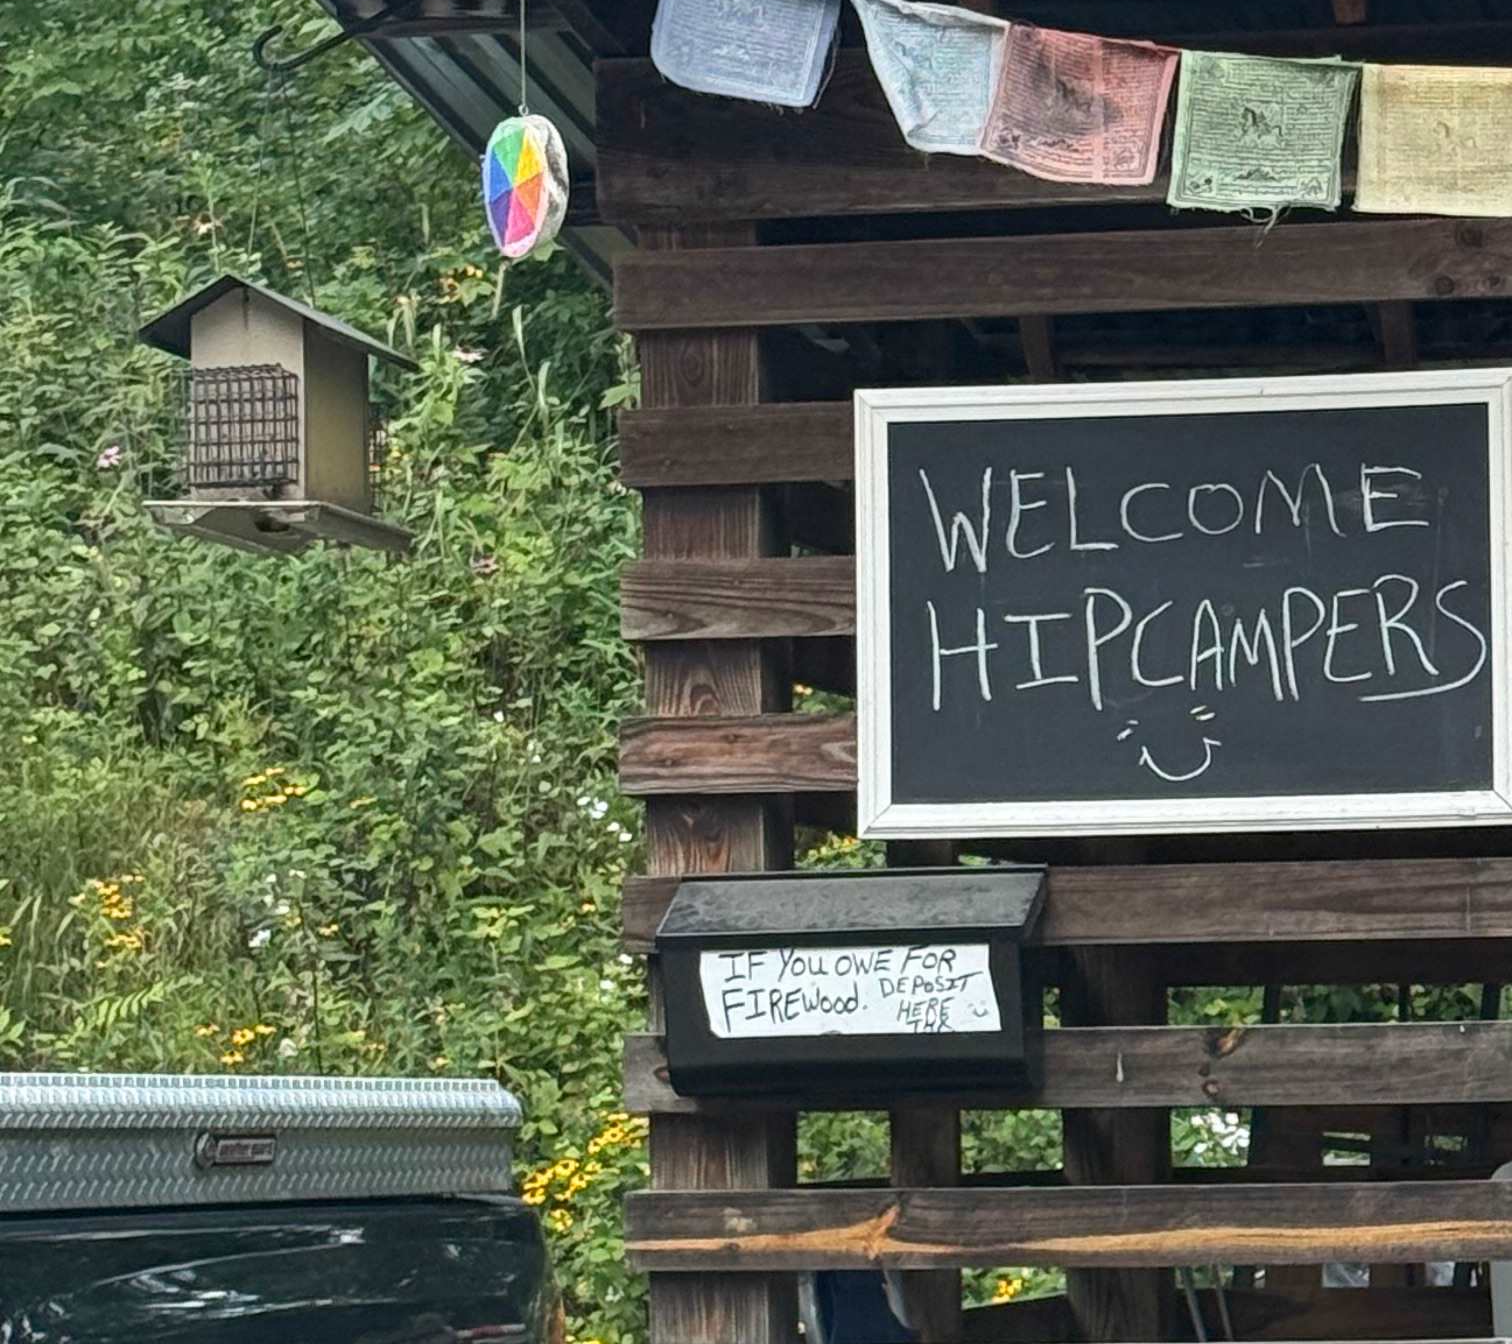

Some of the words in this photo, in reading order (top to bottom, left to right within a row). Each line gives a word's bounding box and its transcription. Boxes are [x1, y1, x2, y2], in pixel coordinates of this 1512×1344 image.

[919, 462, 1429, 573] WELCOME
[926, 574, 1488, 712] HIPCAMPERS
[718, 950, 768, 982] IF
[834, 949, 893, 976] OWE
[900, 944, 956, 974] FOR
[896, 996, 955, 1022] HERE
